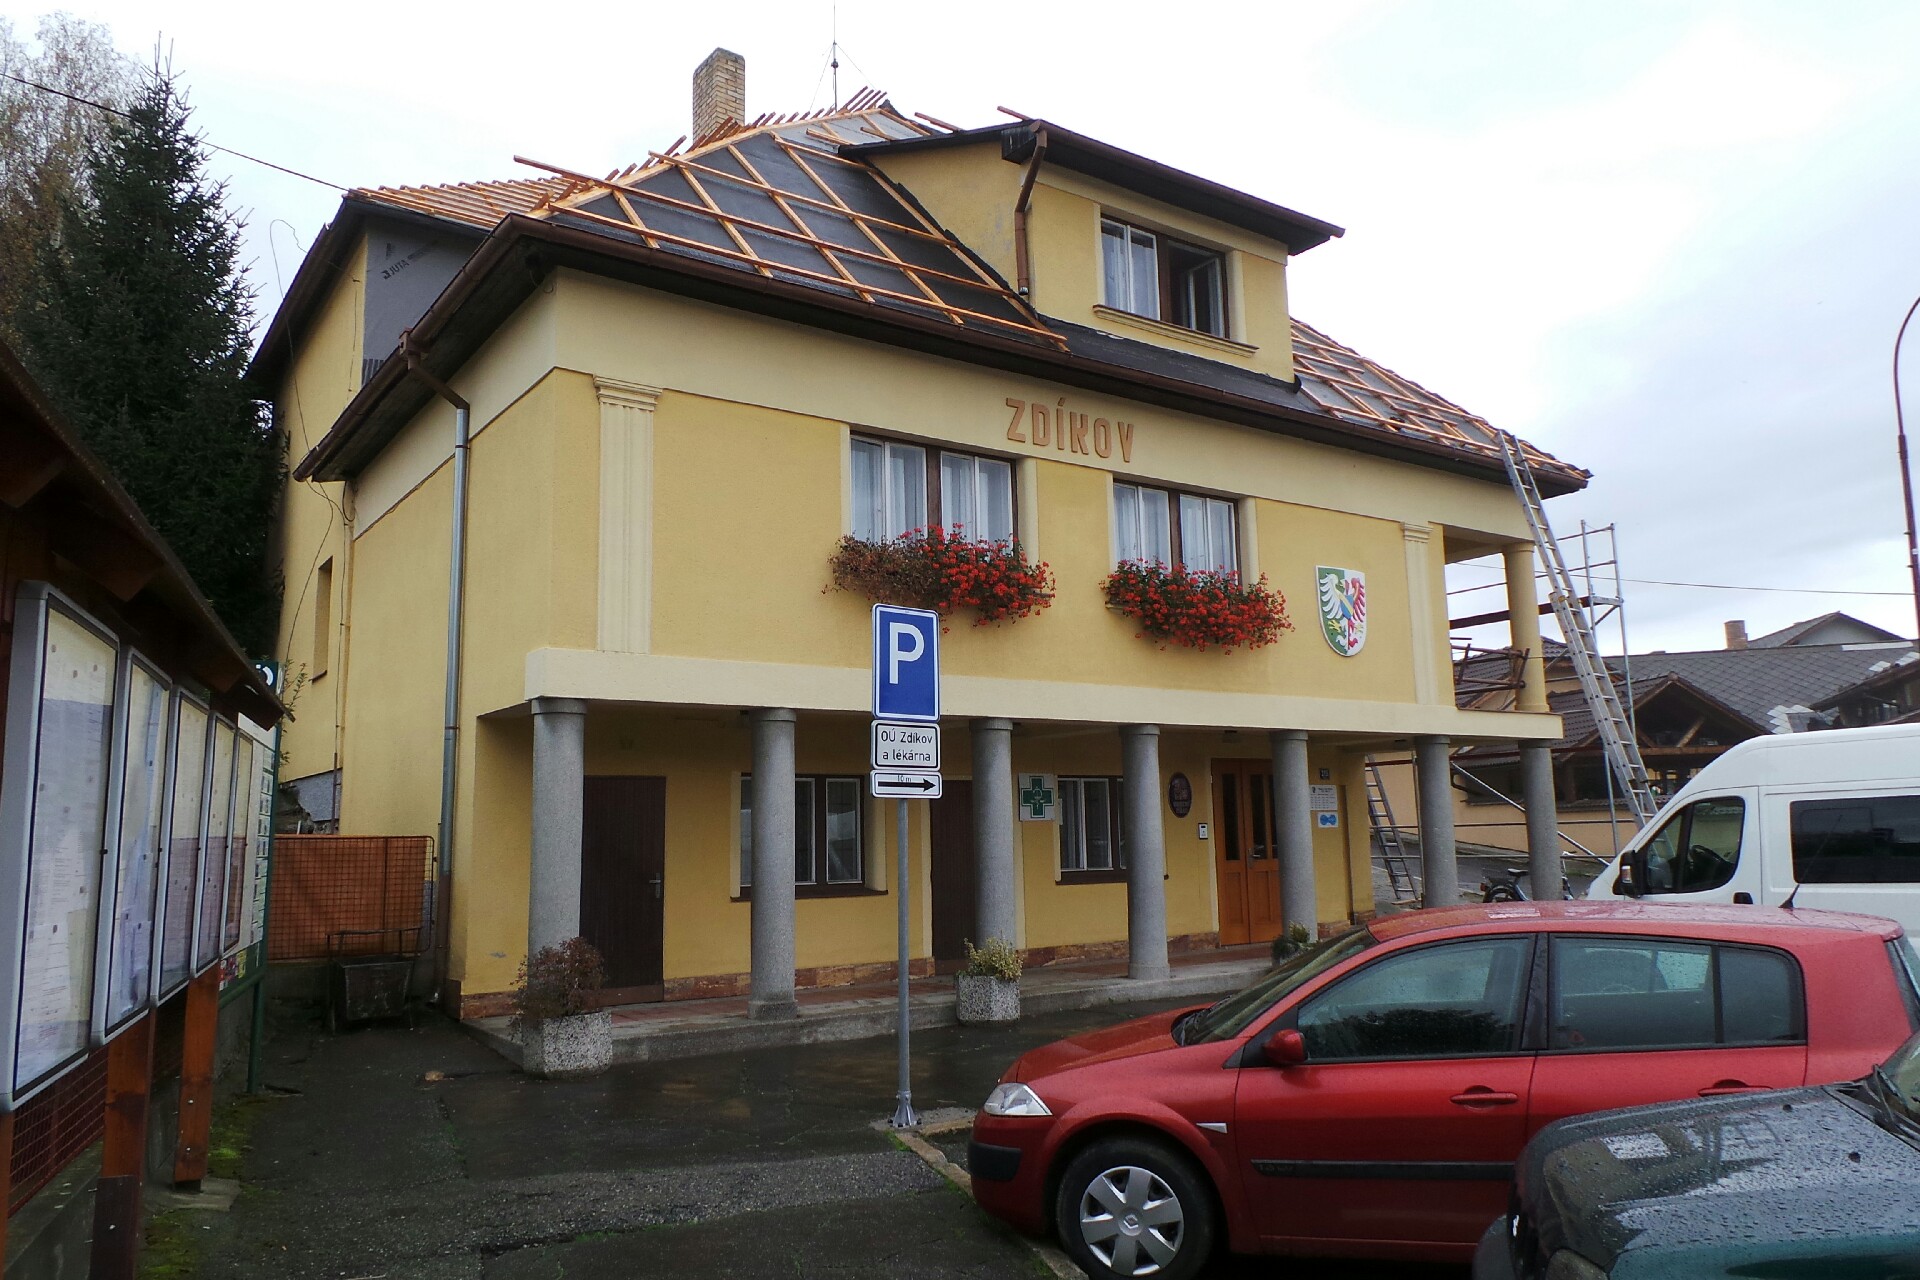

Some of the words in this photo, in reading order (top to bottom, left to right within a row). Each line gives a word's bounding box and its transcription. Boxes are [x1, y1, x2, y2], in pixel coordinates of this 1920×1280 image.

[389, 259, 410, 276] JUTA
[1006, 397, 1135, 463] ZDÍKOV
[889, 621, 925, 685] P
[881, 728, 896, 742] OÚ
[900, 731, 933, 744] Zdíkov
[882, 751, 889, 760] a
[892, 748, 931, 762] lékárna
[897, 774, 904, 782] 10
